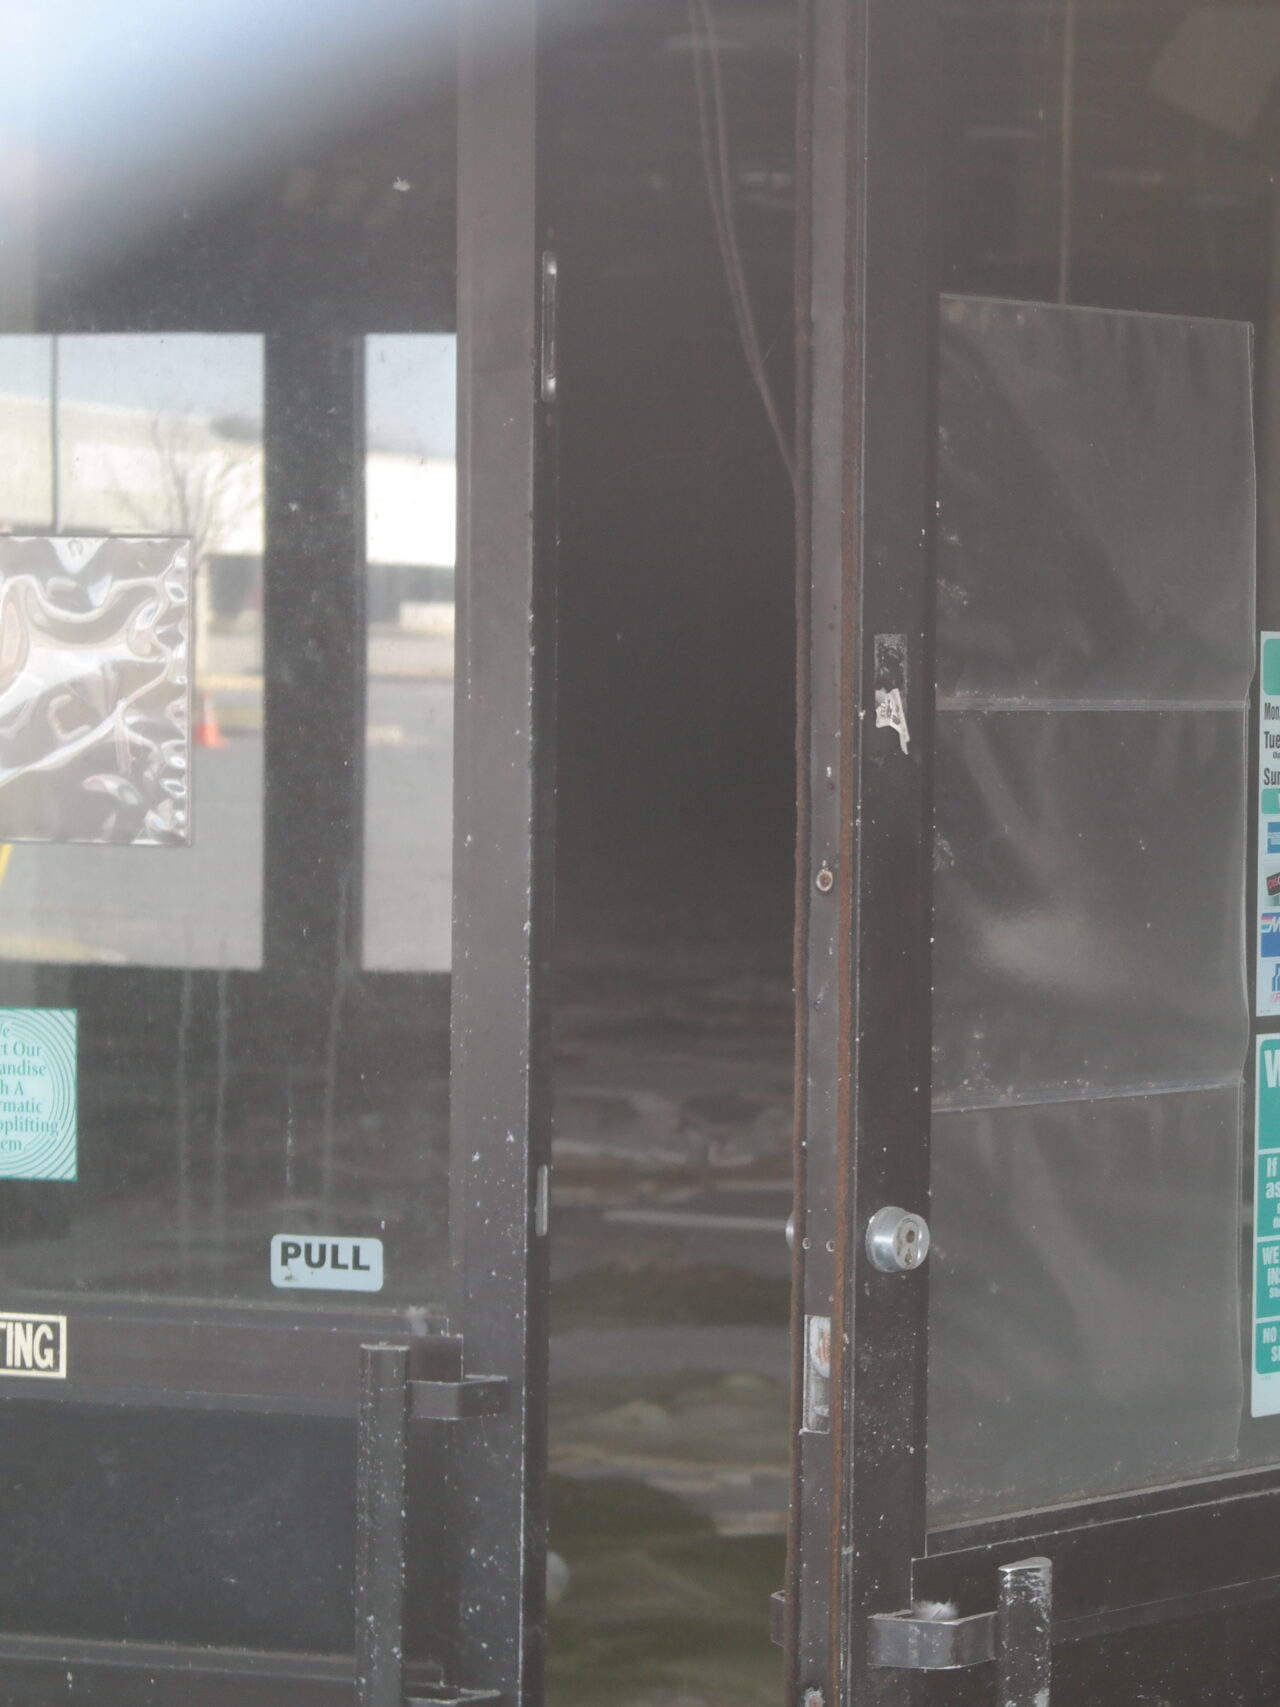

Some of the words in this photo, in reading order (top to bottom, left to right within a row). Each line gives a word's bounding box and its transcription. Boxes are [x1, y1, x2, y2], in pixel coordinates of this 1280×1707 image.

[13, 1040, 41, 1056] Our
[14, 1080, 24, 1096] A
[0, 1096, 42, 1114] matic
[1266, 1157, 1278, 1178] If
[280, 1241, 371, 1272] PULL
[1262, 1246, 1280, 1265] WE
[1263, 1327, 1277, 1344] NO
